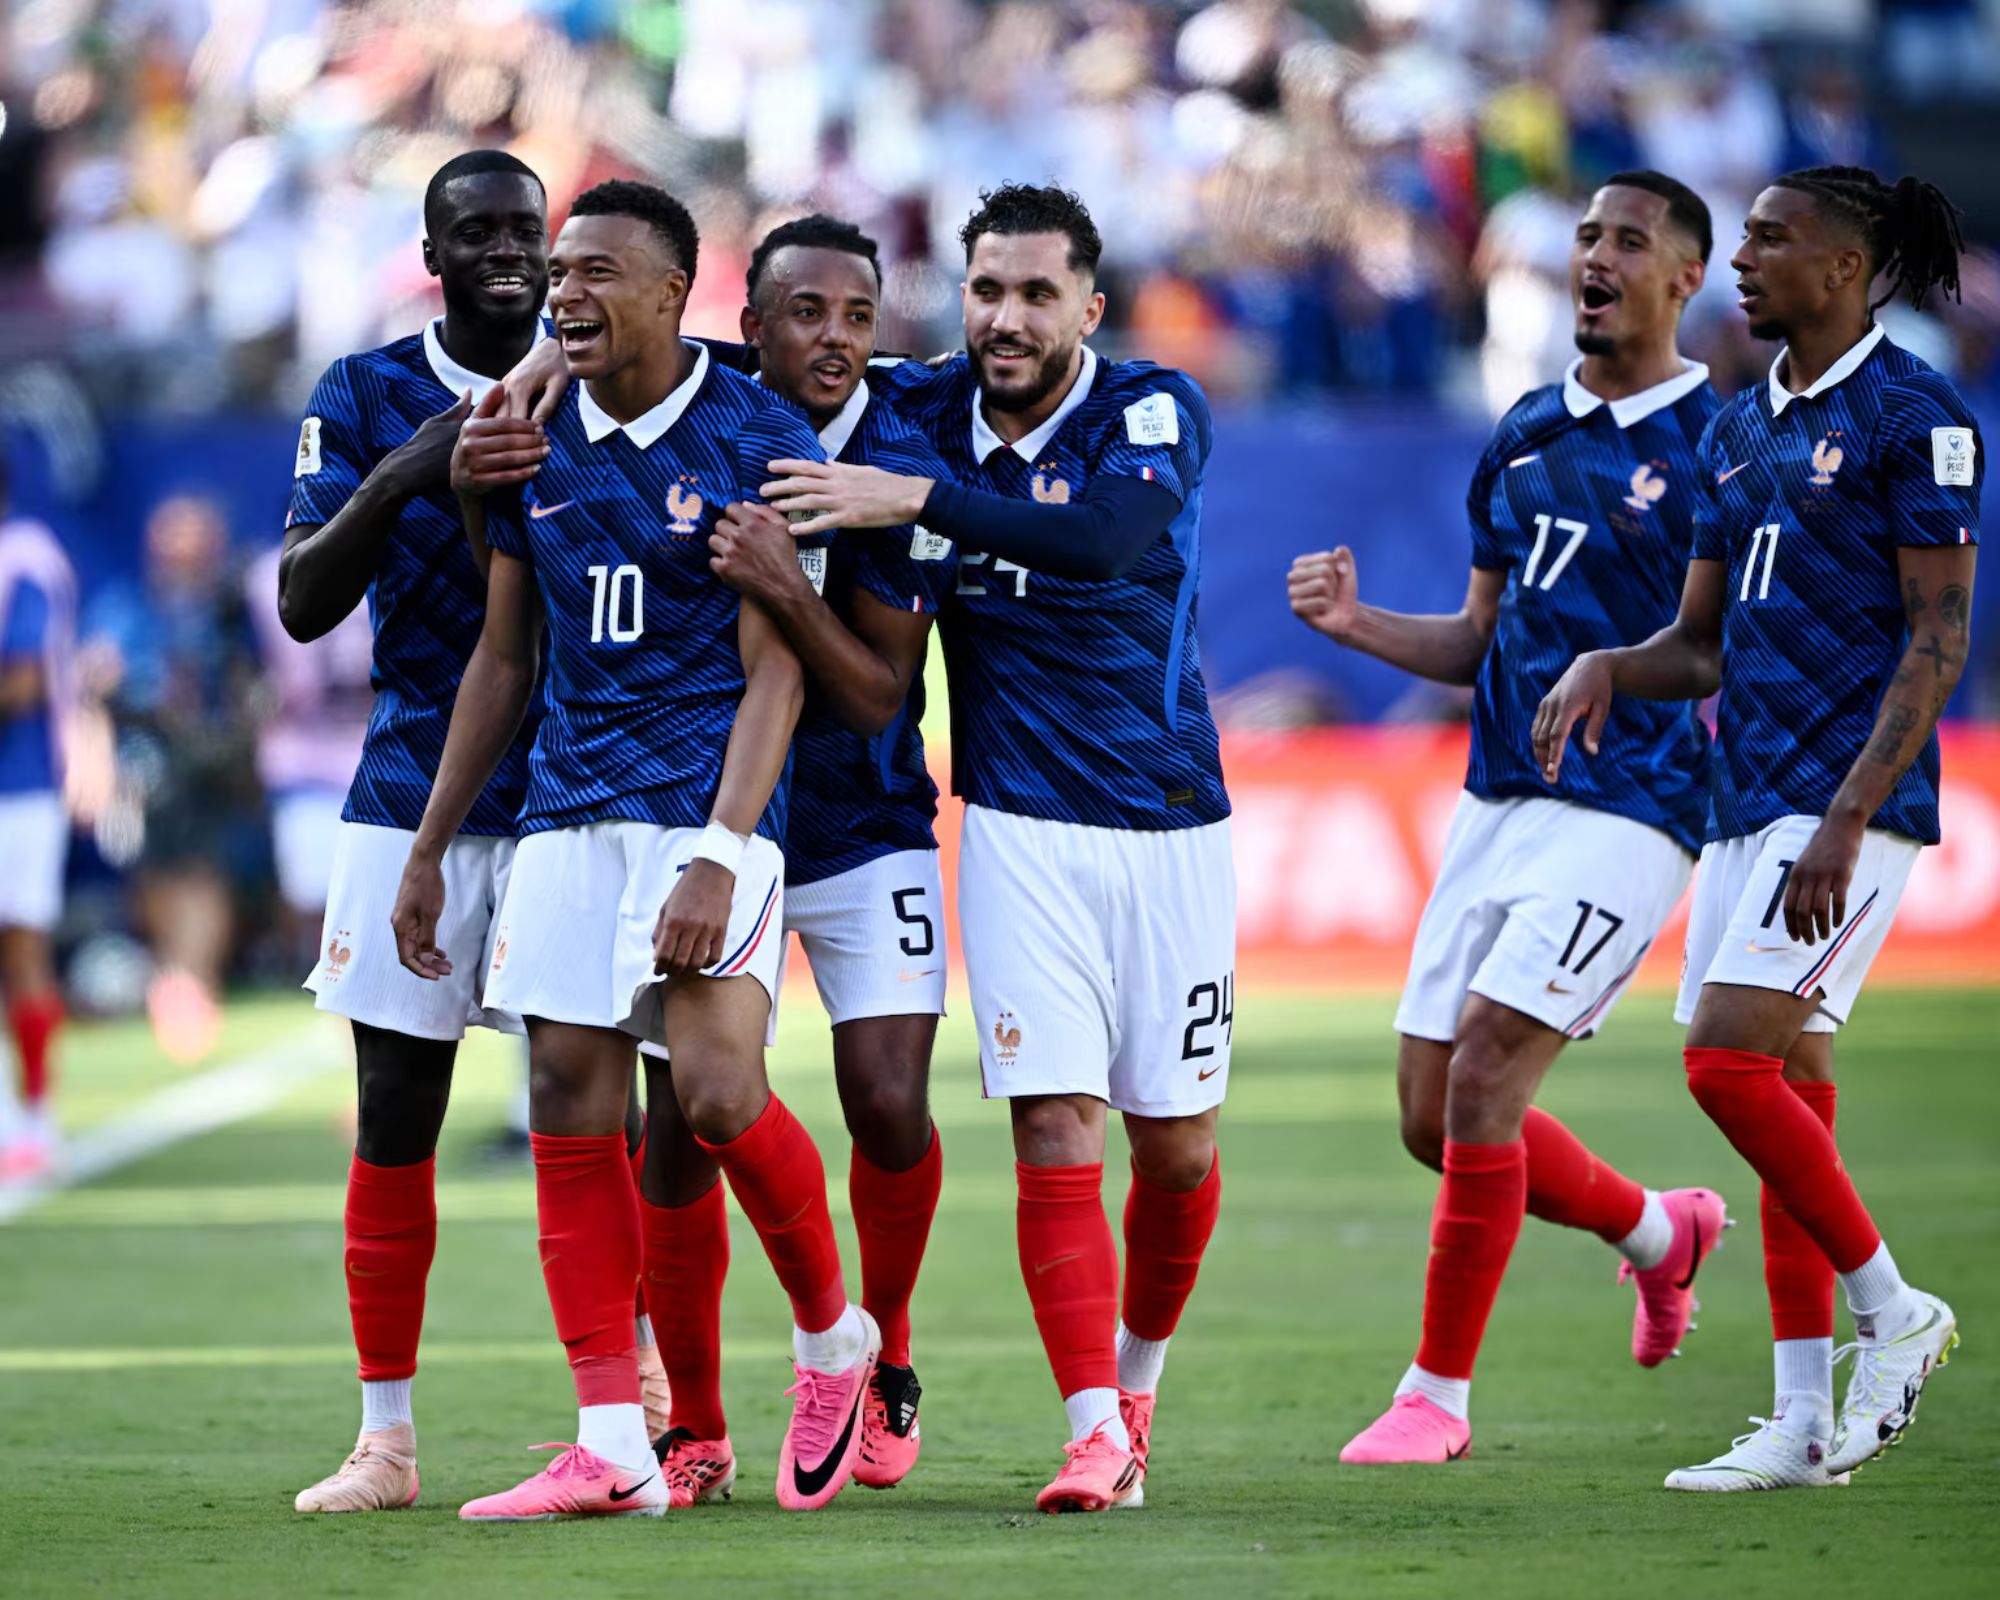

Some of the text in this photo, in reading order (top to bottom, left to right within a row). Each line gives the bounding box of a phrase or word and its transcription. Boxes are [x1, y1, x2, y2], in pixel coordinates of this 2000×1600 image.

[925, 538, 944, 547] PEACE
[1522, 513, 1589, 591] 17
[1740, 523, 1781, 601] 11
[588, 564, 644, 643] 10
[892, 887, 934, 956] 5
[1760, 859, 1796, 929] 1
[1558, 899, 1624, 975] 17
[1181, 970, 1234, 1061] 24
